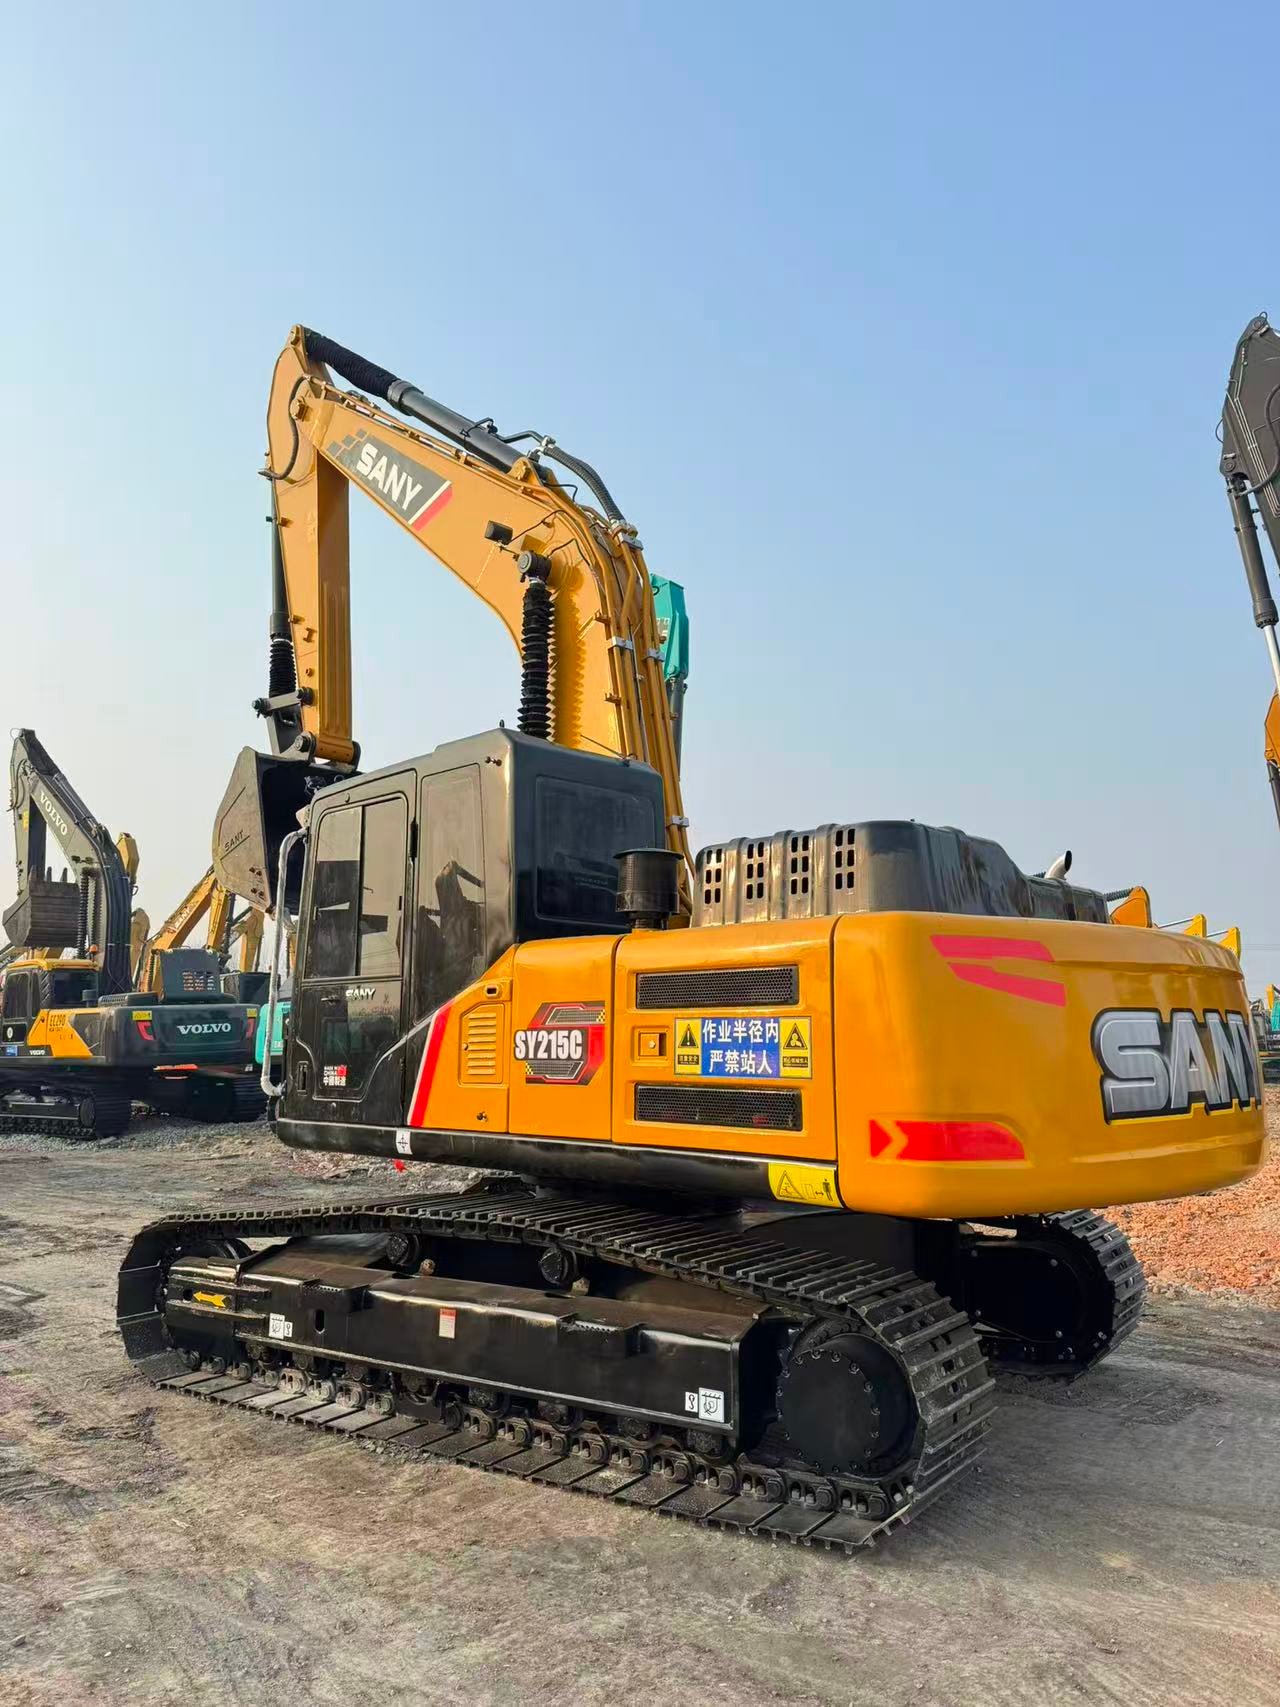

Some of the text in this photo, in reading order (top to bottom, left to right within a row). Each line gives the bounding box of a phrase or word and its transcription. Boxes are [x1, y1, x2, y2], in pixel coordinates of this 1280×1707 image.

[356, 442, 424, 511] SANY
[40, 790, 68, 836] VOLVO
[224, 828, 244, 852] SANY
[345, 988, 376, 1000] SANY
[177, 1022, 231, 1035] VOLVO
[703, 1018, 779, 1044] 作业半径内
[515, 1029, 583, 1060] SY215C
[709, 1050, 773, 1075] 严禁站人
